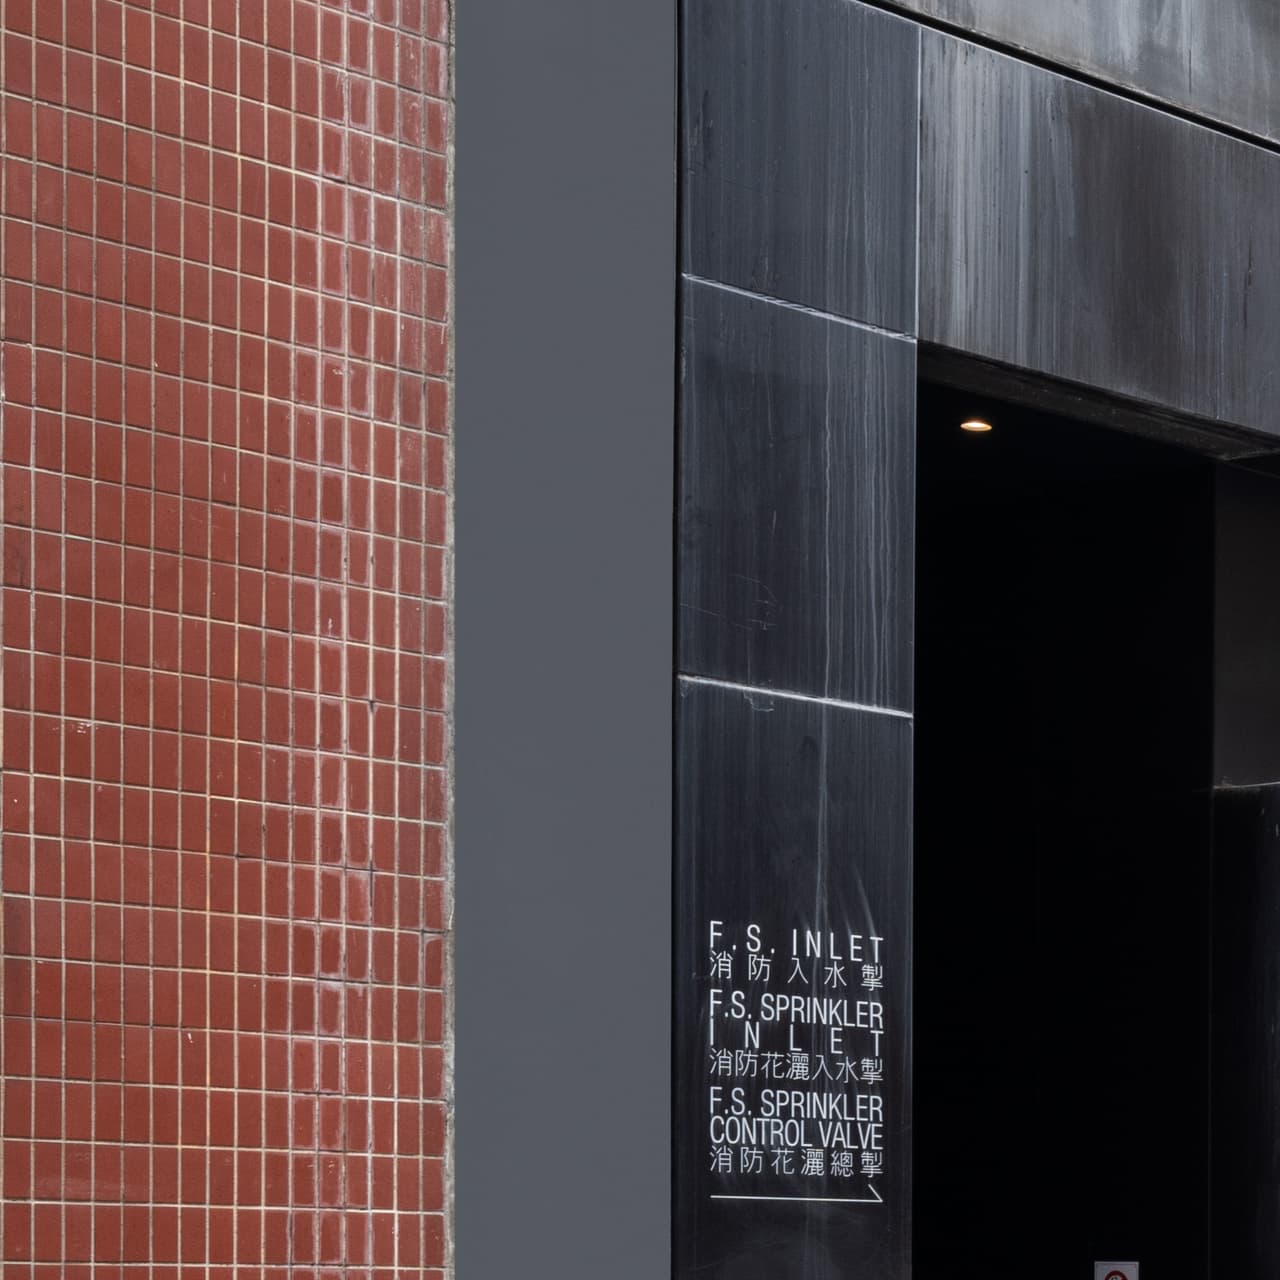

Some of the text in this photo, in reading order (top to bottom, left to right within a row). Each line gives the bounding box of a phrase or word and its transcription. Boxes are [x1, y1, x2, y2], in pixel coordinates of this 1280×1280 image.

[710, 920, 884, 963] F.S. INLET
[710, 989, 884, 1029] F.S. SPRINKLER
[710, 1017, 884, 1057] INLET
[710, 1086, 884, 1122] F.S. SPRINKLER
[710, 1115, 884, 1150] CONTROL VALVE
